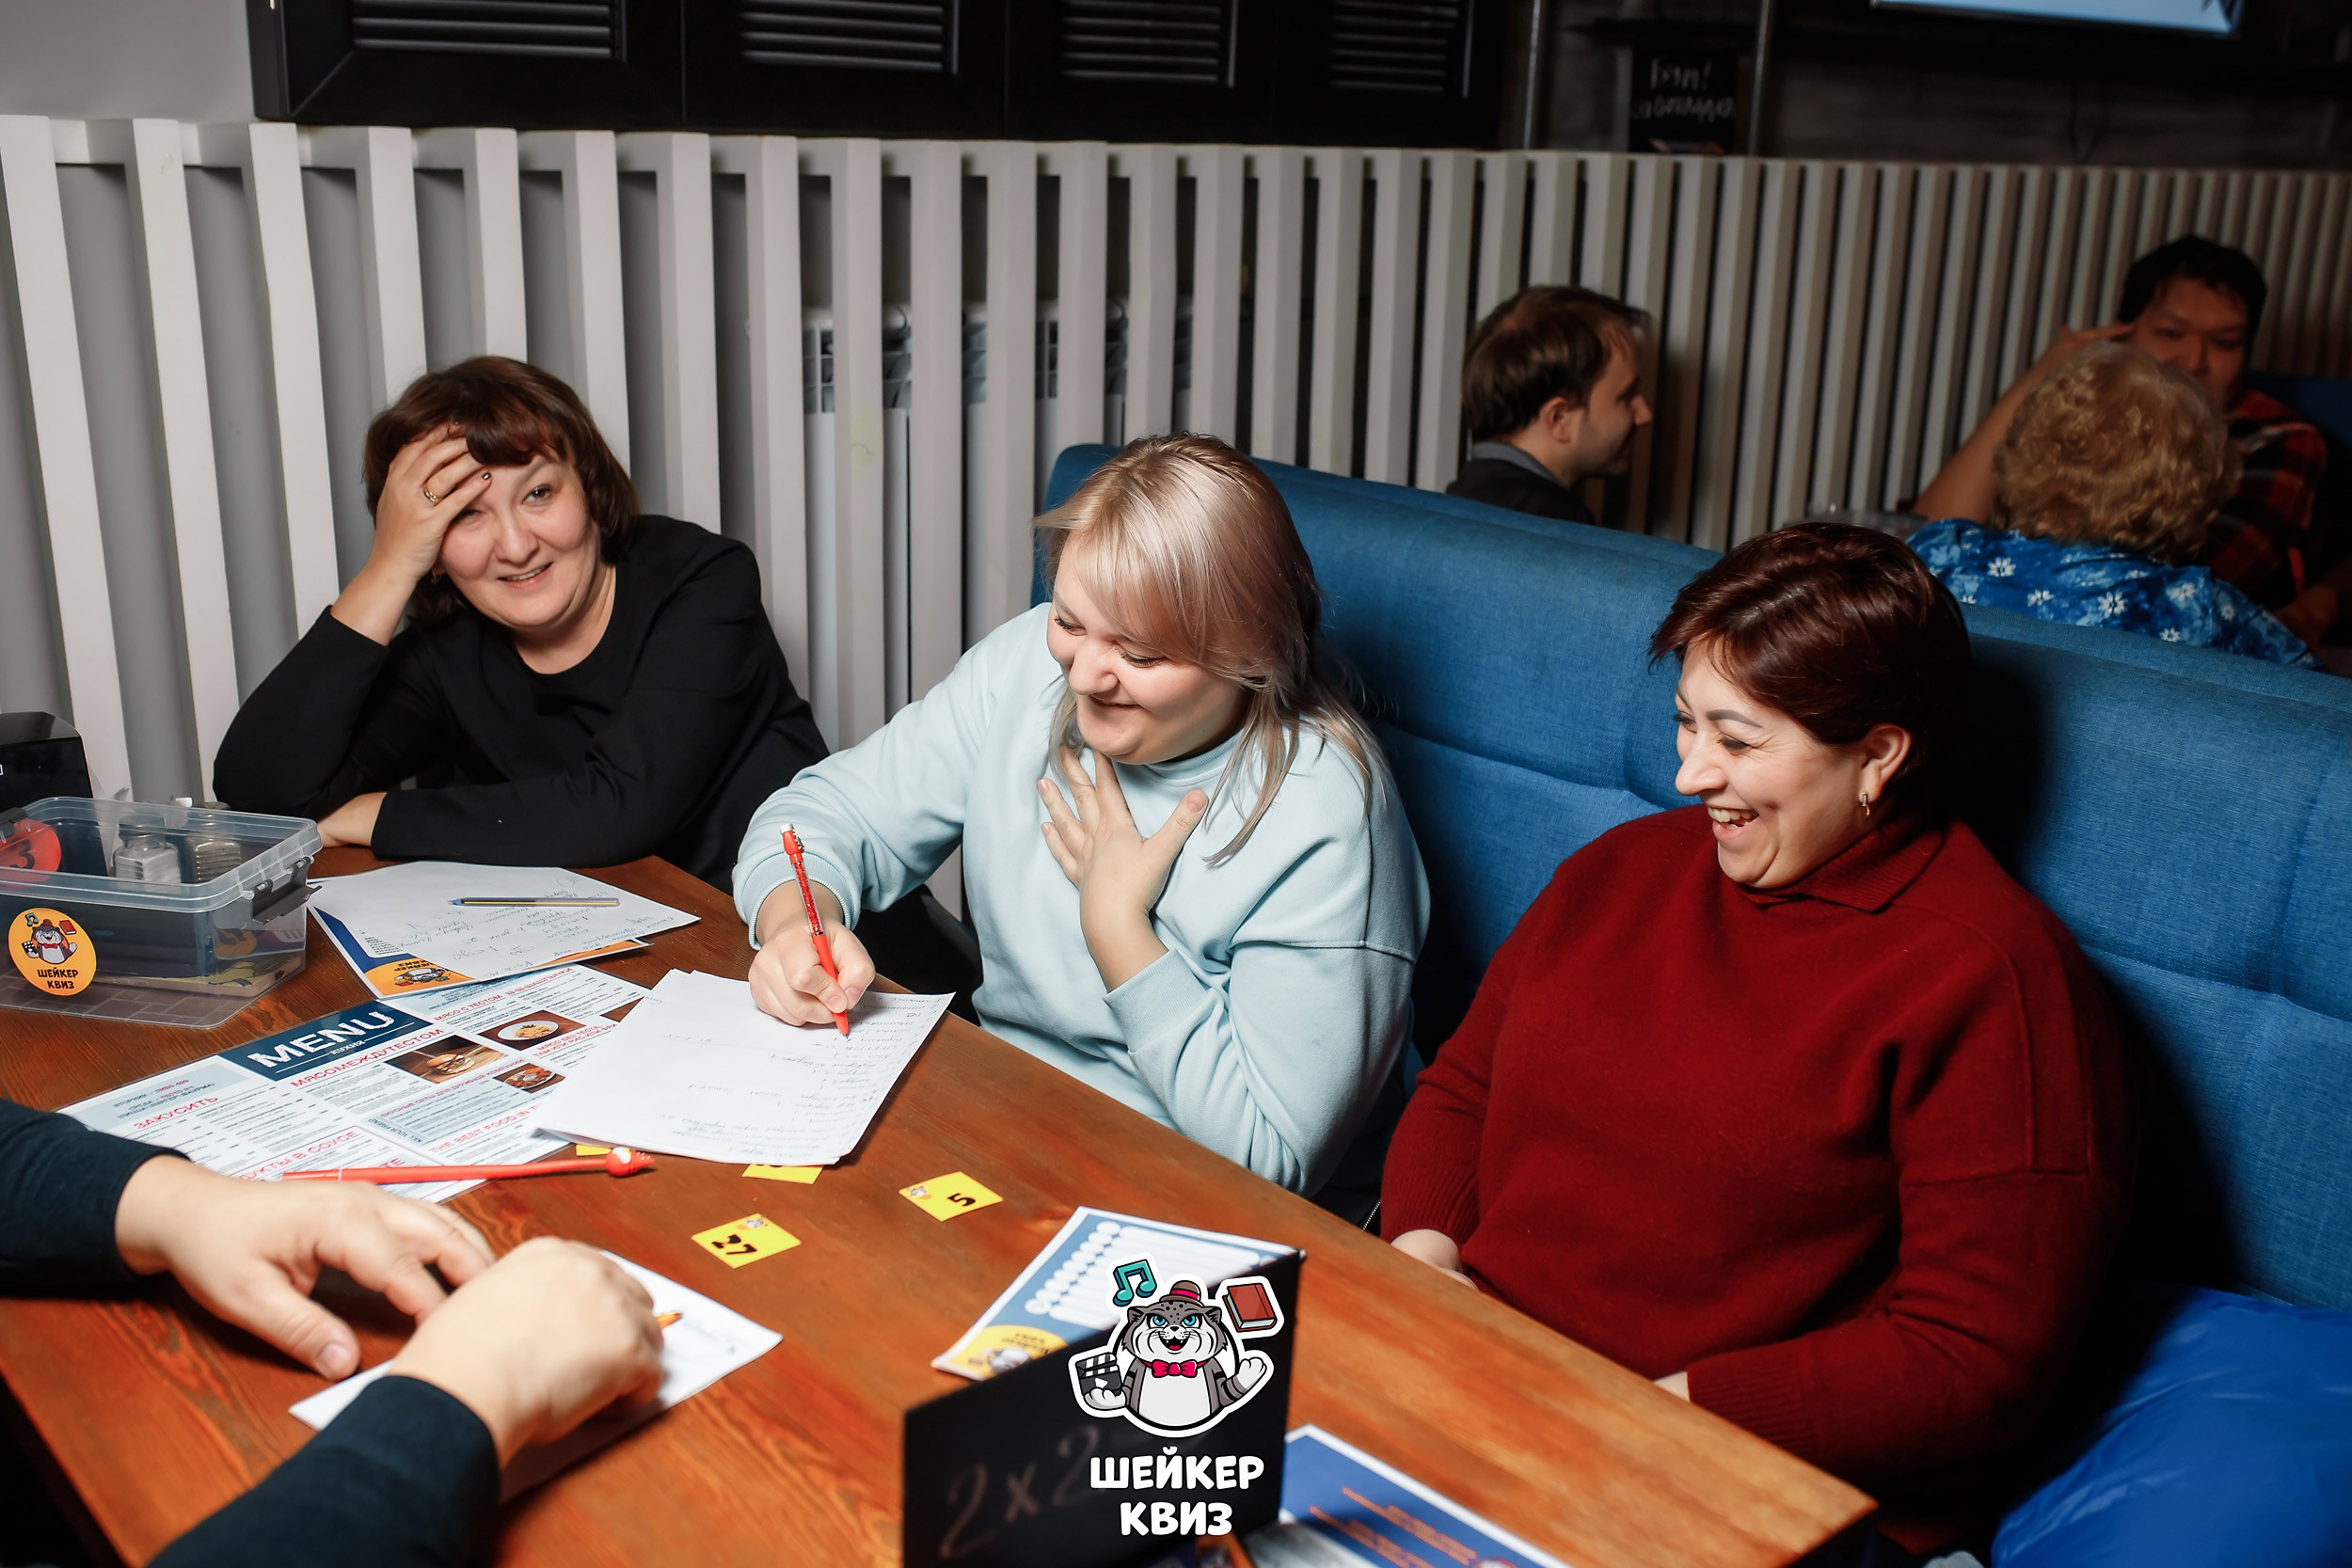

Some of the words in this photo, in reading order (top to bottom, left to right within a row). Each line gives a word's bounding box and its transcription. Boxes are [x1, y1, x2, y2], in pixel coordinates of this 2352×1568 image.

[37, 967, 79, 979] ШЕЙКЕР
[46, 978, 75, 990] КВИЗ
[434, 1009, 460, 1020] МЯСО
[469, 994, 502, 1007] ТЕСТОМ
[247, 1011, 394, 1069] MENU
[330, 1039, 366, 1055] КУХНЯ
[290, 1028, 444, 1087] МЯСОМЕЖДУТЕСТОМ
[134, 1096, 218, 1129] ЗАКУСИТЬ
[307, 1131, 358, 1153] СОУСЕ
[429, 1141, 453, 1152] THE
[453, 1129, 484, 1143] BEST
[484, 1115, 516, 1130] FOOD
[947, 1193, 976, 1207] 5
